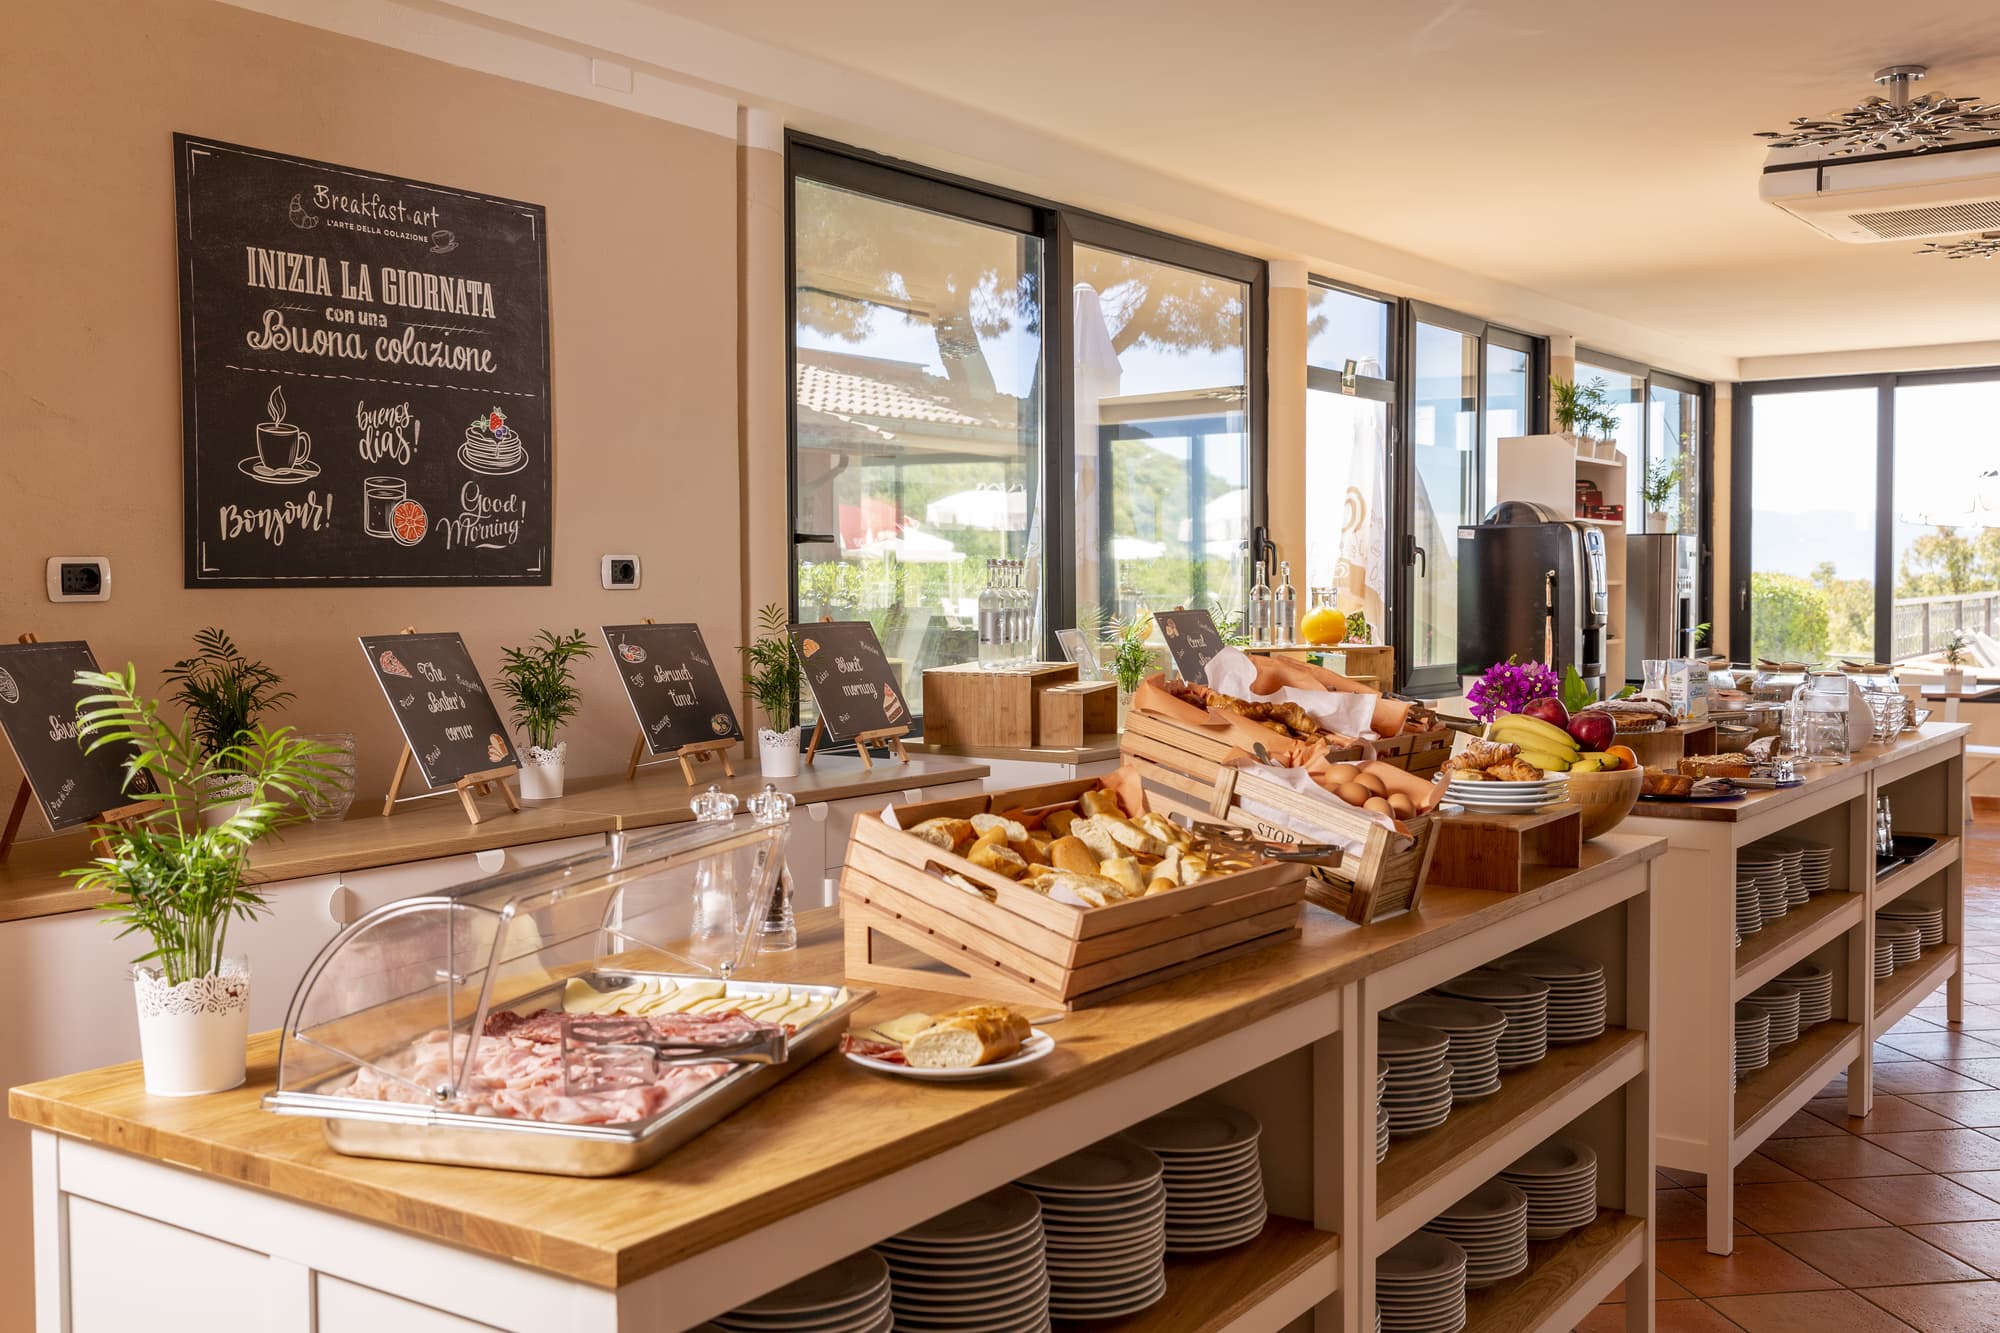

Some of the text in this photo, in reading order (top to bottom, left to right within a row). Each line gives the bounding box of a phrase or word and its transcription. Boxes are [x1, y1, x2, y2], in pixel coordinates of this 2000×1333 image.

[313, 184, 440, 228] Breakfast art
[326, 219, 429, 243] L'ARTE DELLA COLAZIONE
[246, 245, 497, 319] INIZIA LA GIORNATA
[325, 306, 388, 328] con una
[246, 309, 498, 374] Buona colazione
[356, 400, 414, 431] buenos
[219, 490, 334, 546] Bonjour!
[416, 660, 447, 683] The
[653, 664, 694, 684] Brunch
[834, 655, 864, 675] Sweet
[668, 681, 700, 707] time!
[842, 678, 878, 700] morning
[428, 691, 467, 714] Baker's
[445, 724, 474, 742] corner
